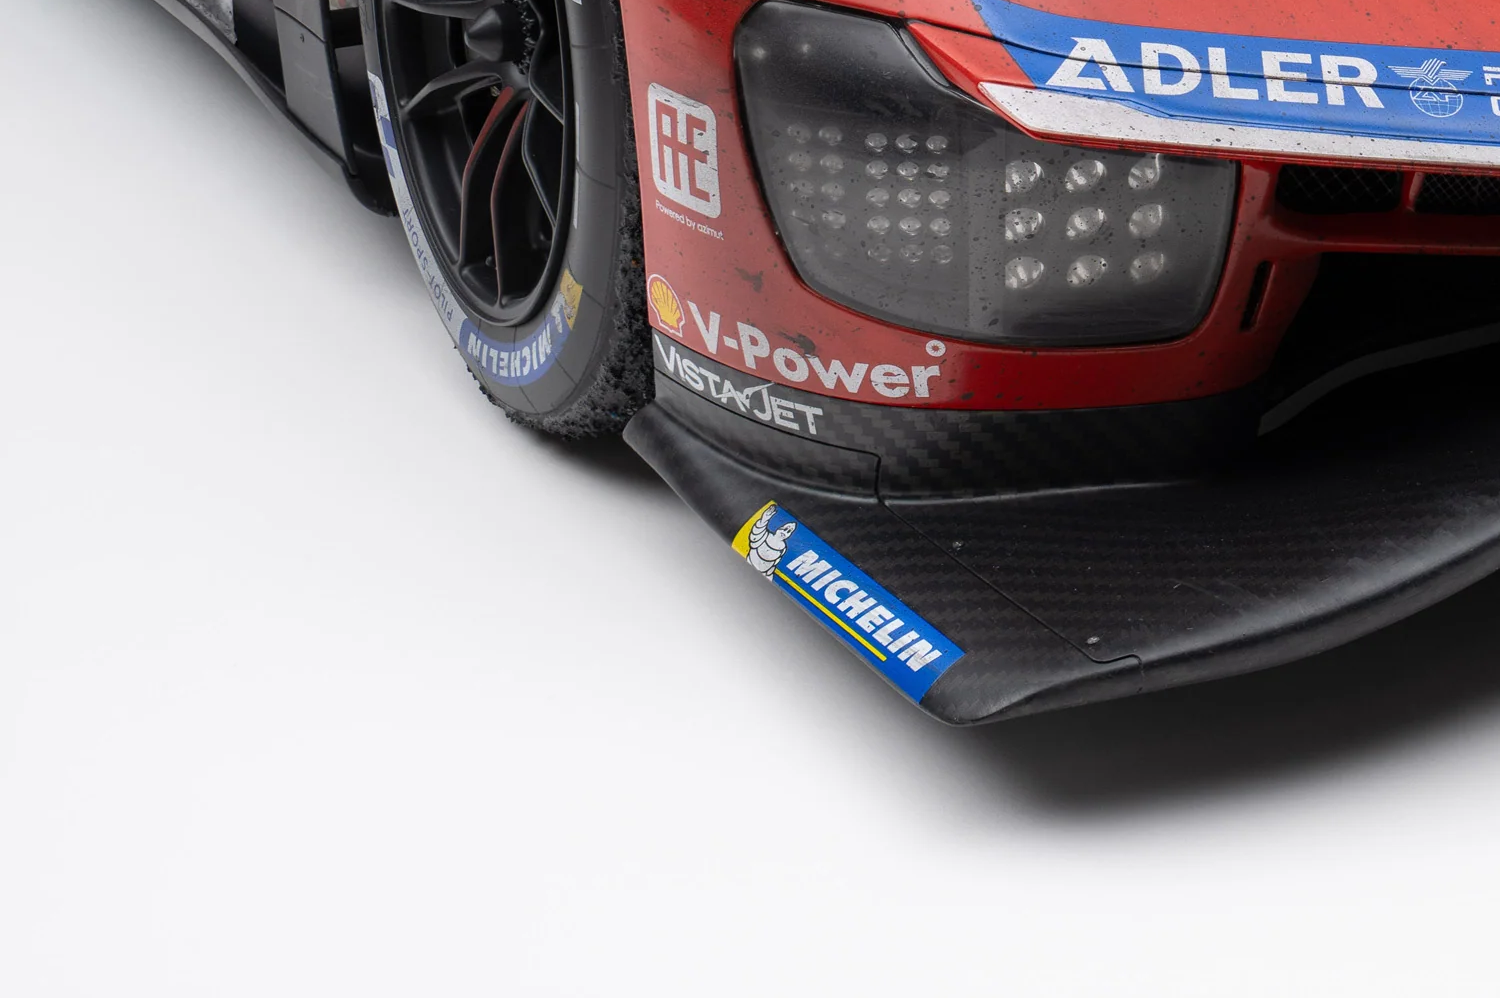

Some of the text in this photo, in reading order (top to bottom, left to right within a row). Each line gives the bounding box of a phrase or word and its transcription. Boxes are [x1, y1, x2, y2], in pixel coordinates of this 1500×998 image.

[1045, 36, 1385, 110] ADLER
[655, 199, 724, 241] Powered by azimut
[467, 322, 552, 379] MICHELIN
[687, 300, 941, 399] V-Power
[785, 549, 943, 673] MICHELIN
